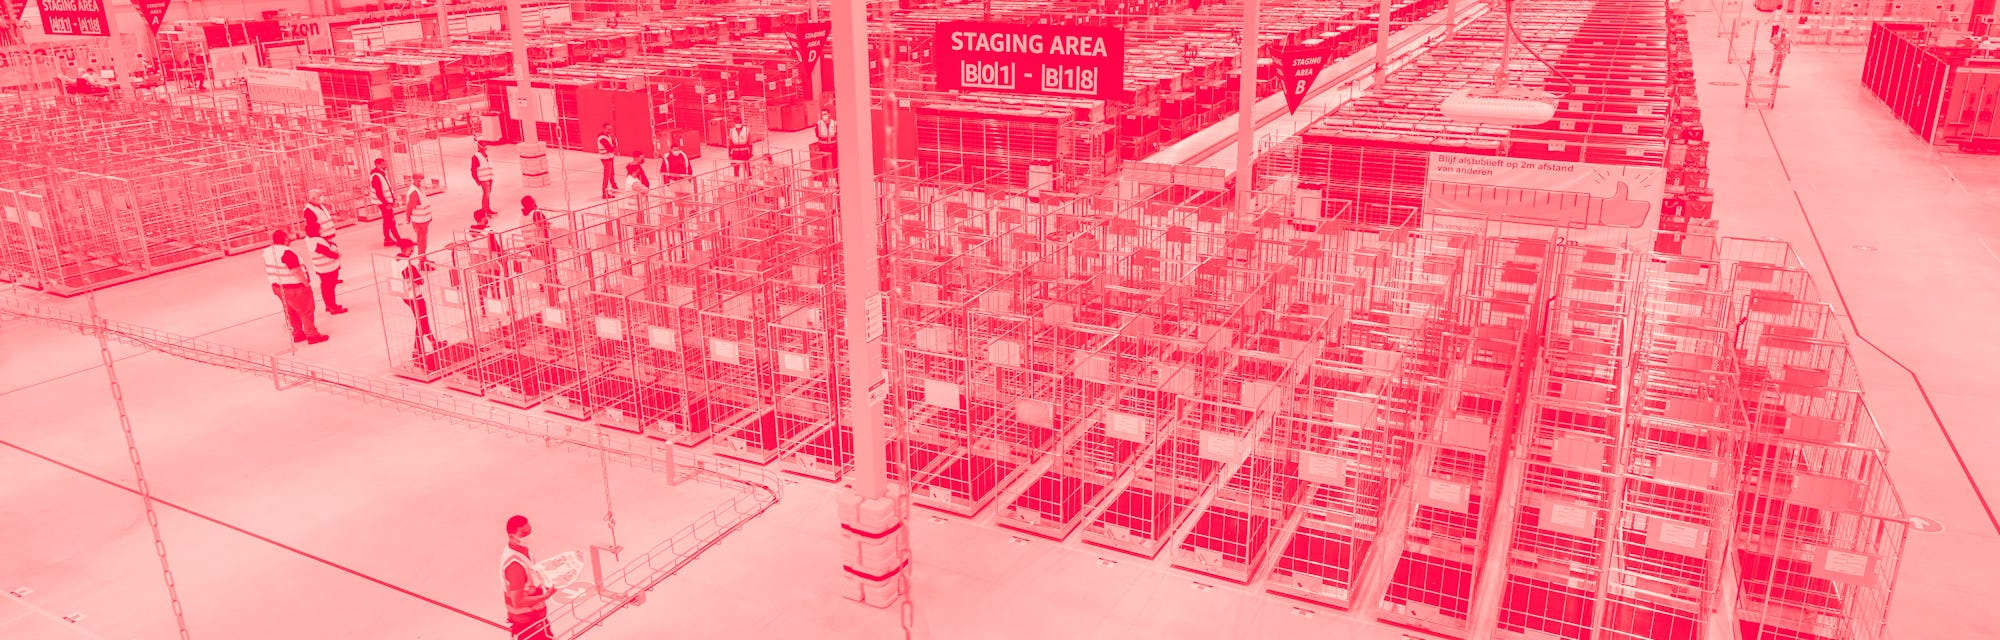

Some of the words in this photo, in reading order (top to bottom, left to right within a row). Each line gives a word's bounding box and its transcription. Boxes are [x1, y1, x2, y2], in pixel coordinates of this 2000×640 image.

[42, 0, 77, 11] STAGING
[78, 0, 100, 12] AREA
[151, 16, 160, 25] A
[952, 31, 1043, 54] STAGING
[1049, 35, 1107, 58] AREA
[808, 50, 817, 62] D
[1291, 56, 1322, 67] STAGING
[964, 62, 1011, 85] B01
[1045, 67, 1095, 90] B18
[1294, 68, 1313, 77] AREA
[1294, 79, 1306, 95] B
[1438, 154, 1456, 165] Blijf
[1458, 157, 1504, 168] alstublieft
[1506, 161, 1518, 169] op
[1521, 161, 1535, 169] 2m
[1538, 162, 1574, 172] afstand
[1437, 165, 1453, 173] van
[1455, 167, 1493, 176] anderen
